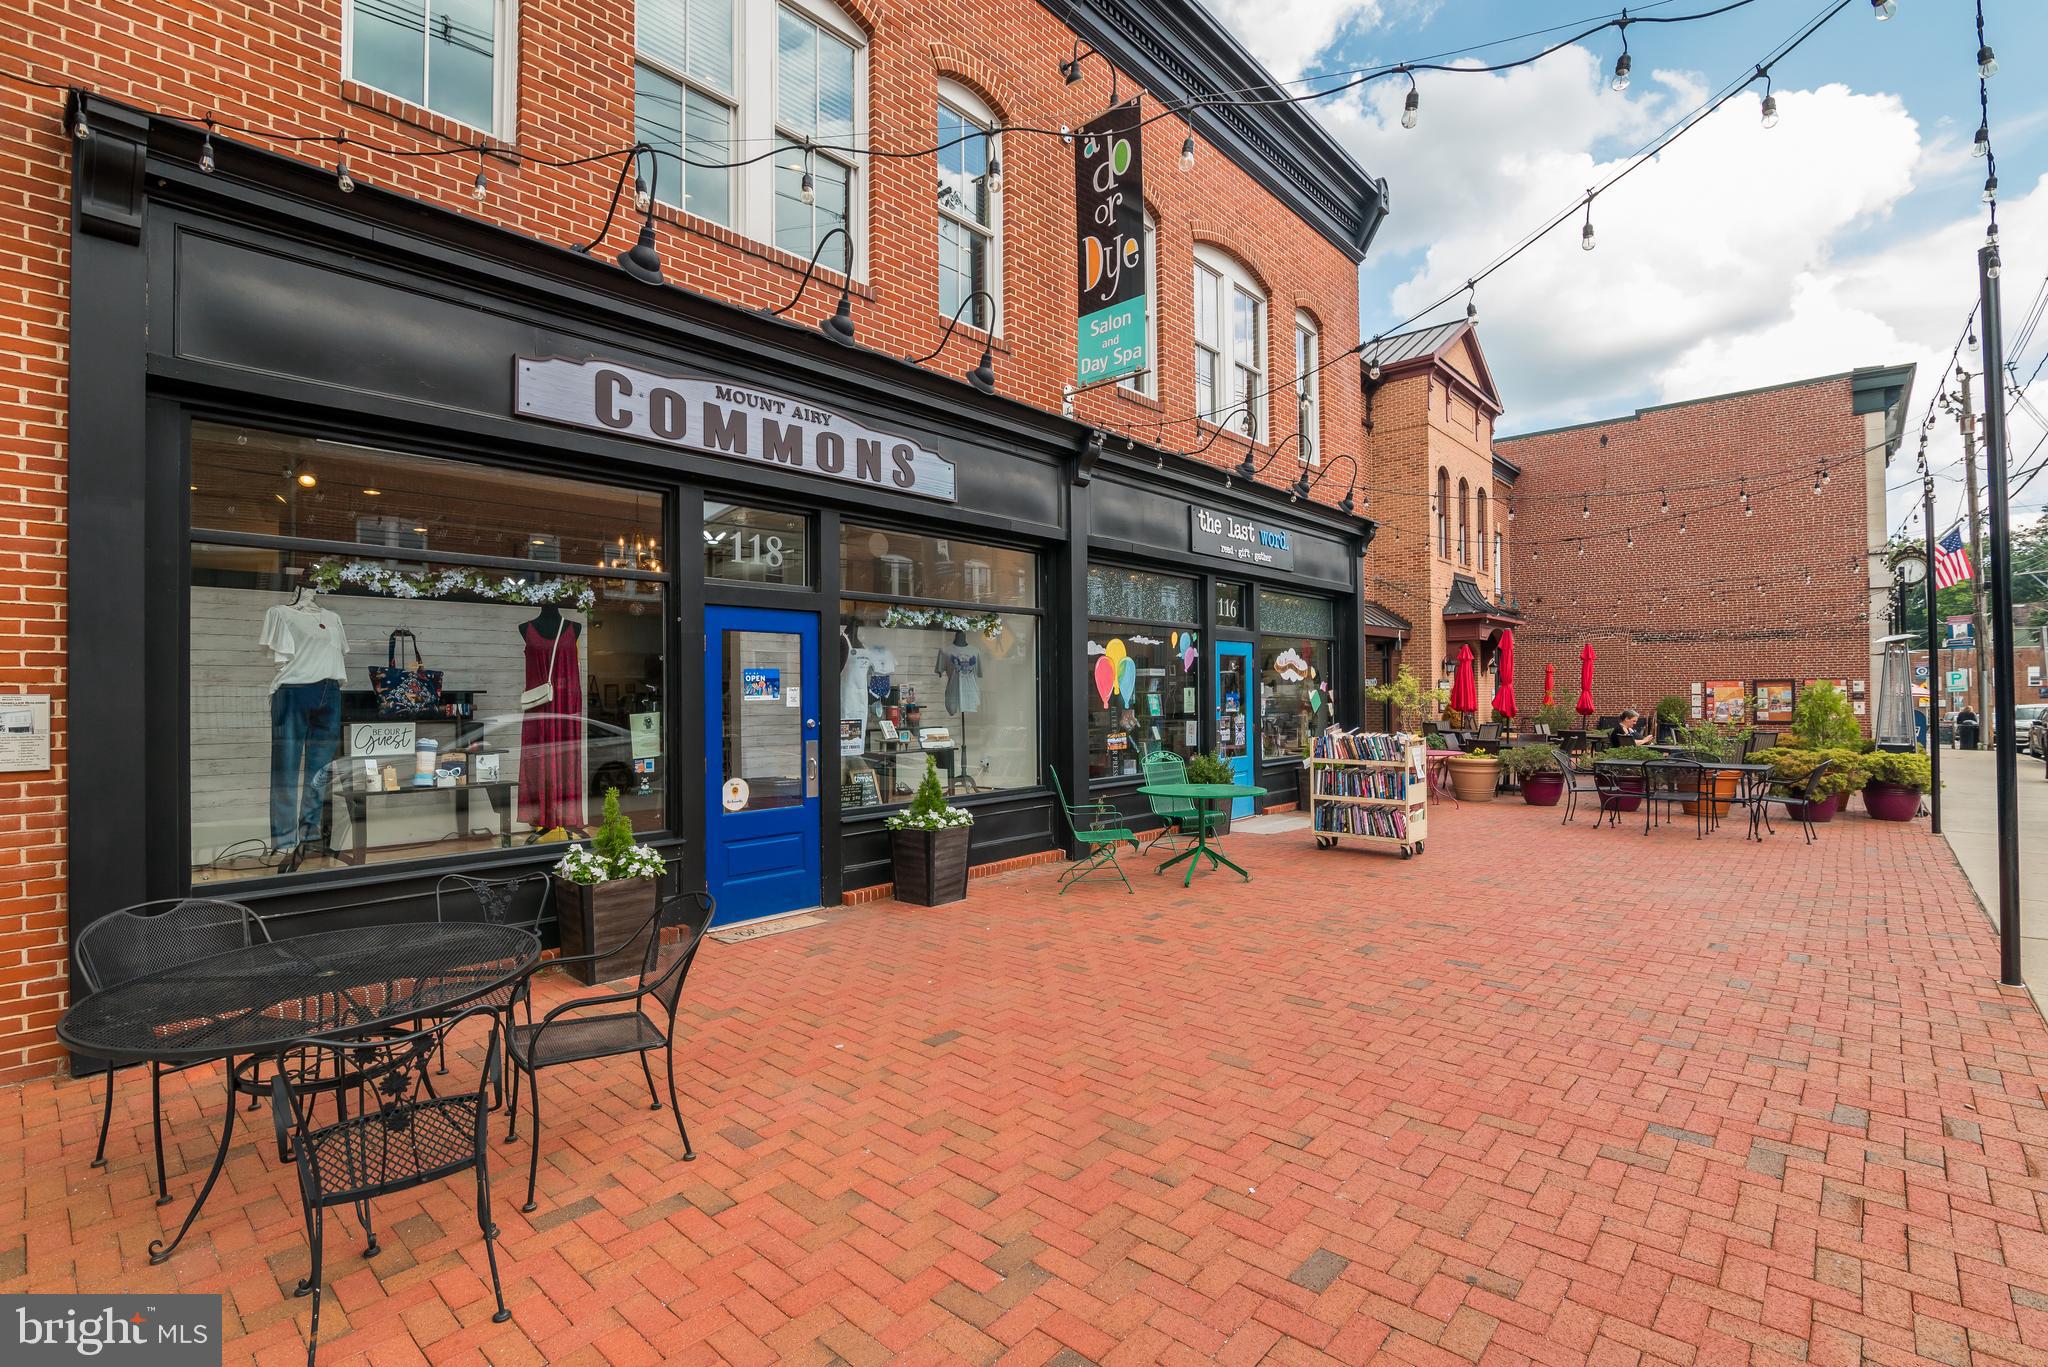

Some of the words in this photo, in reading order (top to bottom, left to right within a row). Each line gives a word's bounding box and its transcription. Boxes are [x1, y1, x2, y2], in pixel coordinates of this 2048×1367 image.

[1093, 129, 1132, 192] do
[1095, 192, 1123, 226] or
[1083, 233, 1139, 301] Dye
[1091, 313, 1131, 337] Salon
[1102, 334, 1119, 348] and
[1081, 355, 1108, 374] Day
[1113, 346, 1142, 366] Spa
[715, 385, 785, 414] MOUNT
[791, 406, 832, 426] AIRY
[595, 369, 915, 488] COMMONS
[1198, 509, 1222, 535] the
[1226, 517, 1255, 542] last
[729, 531, 783, 567] 118
[1218, 598, 1237, 618] 116
[1951, 673, 1962, 685] P
[355, 725, 412, 754] Guest
[373, 728, 382, 736] BE
[384, 728, 400, 736] OUR
